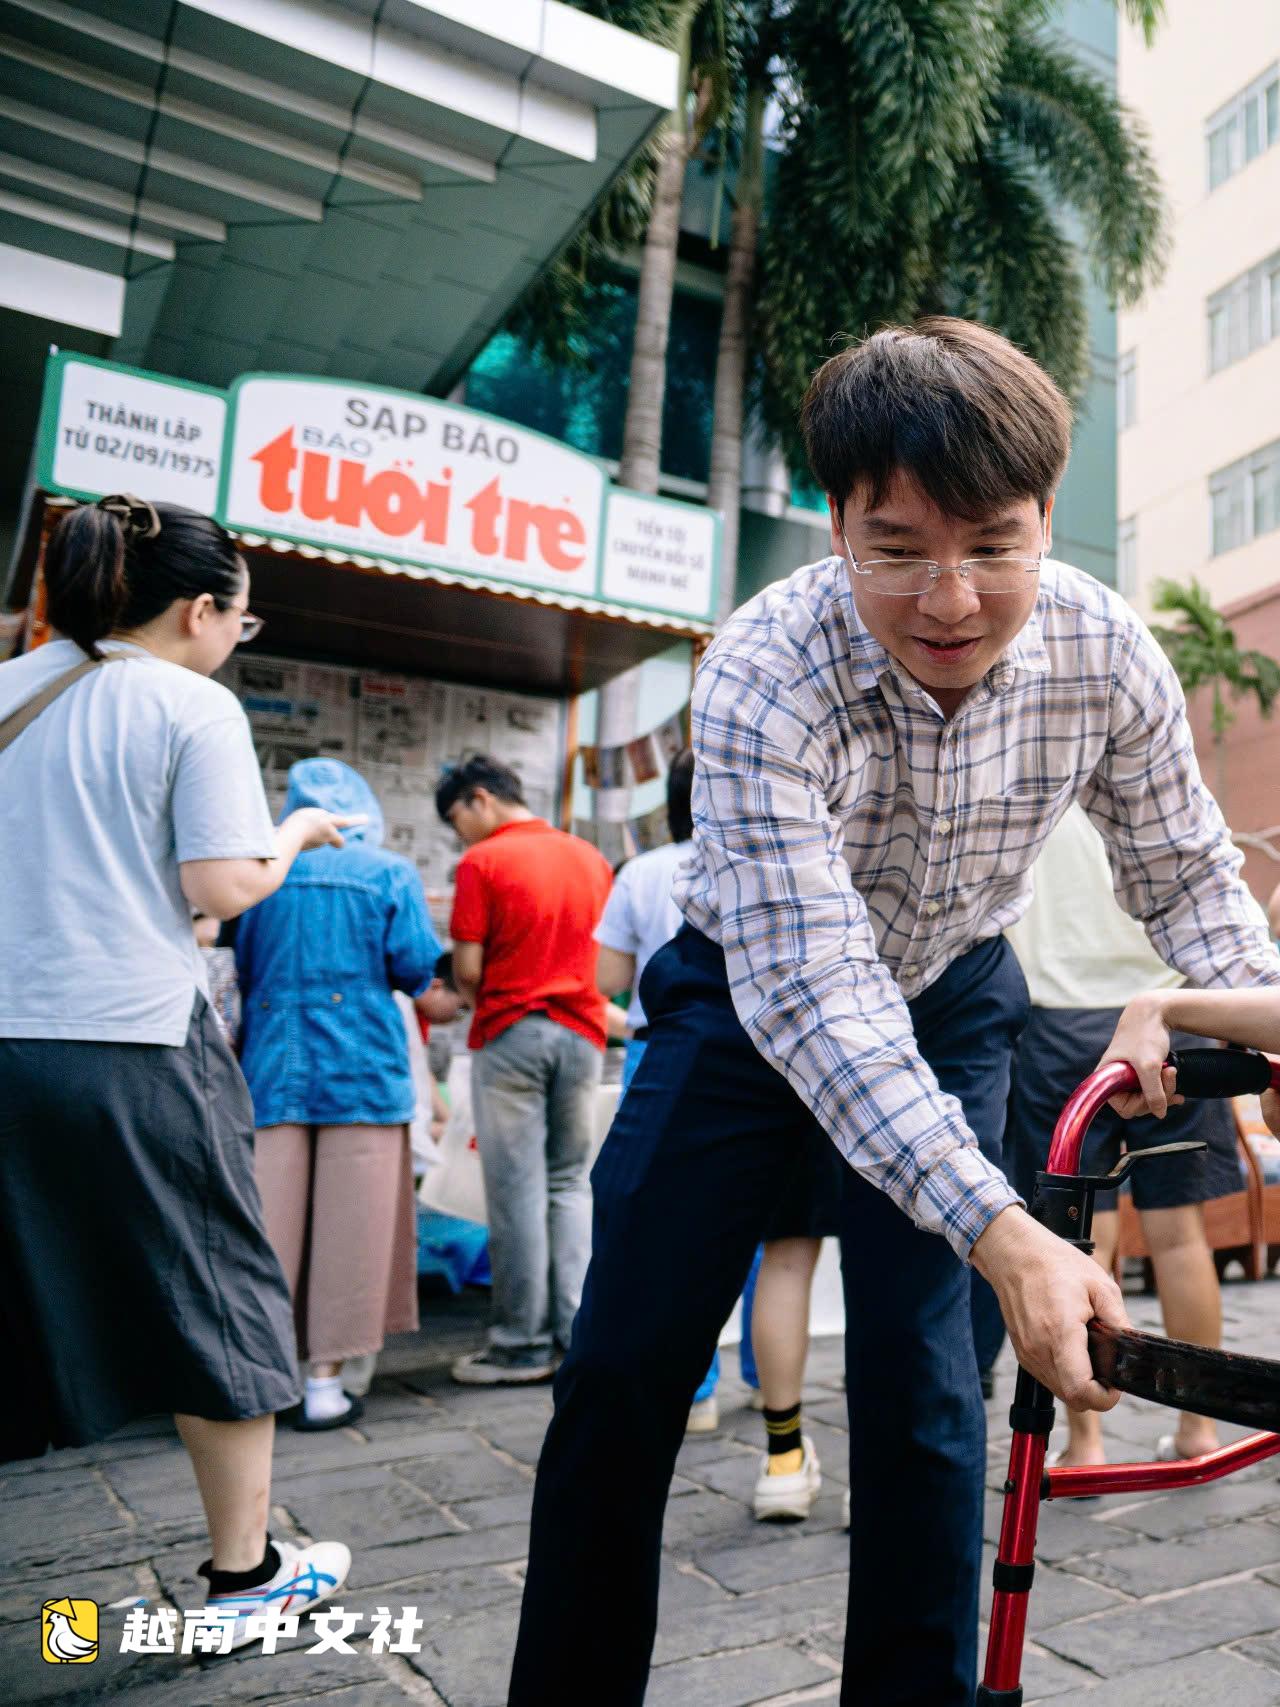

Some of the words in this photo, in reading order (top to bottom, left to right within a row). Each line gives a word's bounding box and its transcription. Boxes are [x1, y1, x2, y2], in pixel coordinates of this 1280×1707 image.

[87, 399, 158, 434] THÀNH
[163, 417, 201, 445] LẬP
[344, 398, 427, 440] SẠP
[442, 424, 519, 465] BÁO
[64, 425, 90, 449] TỪ
[95, 434, 215, 479] 02/09/1975
